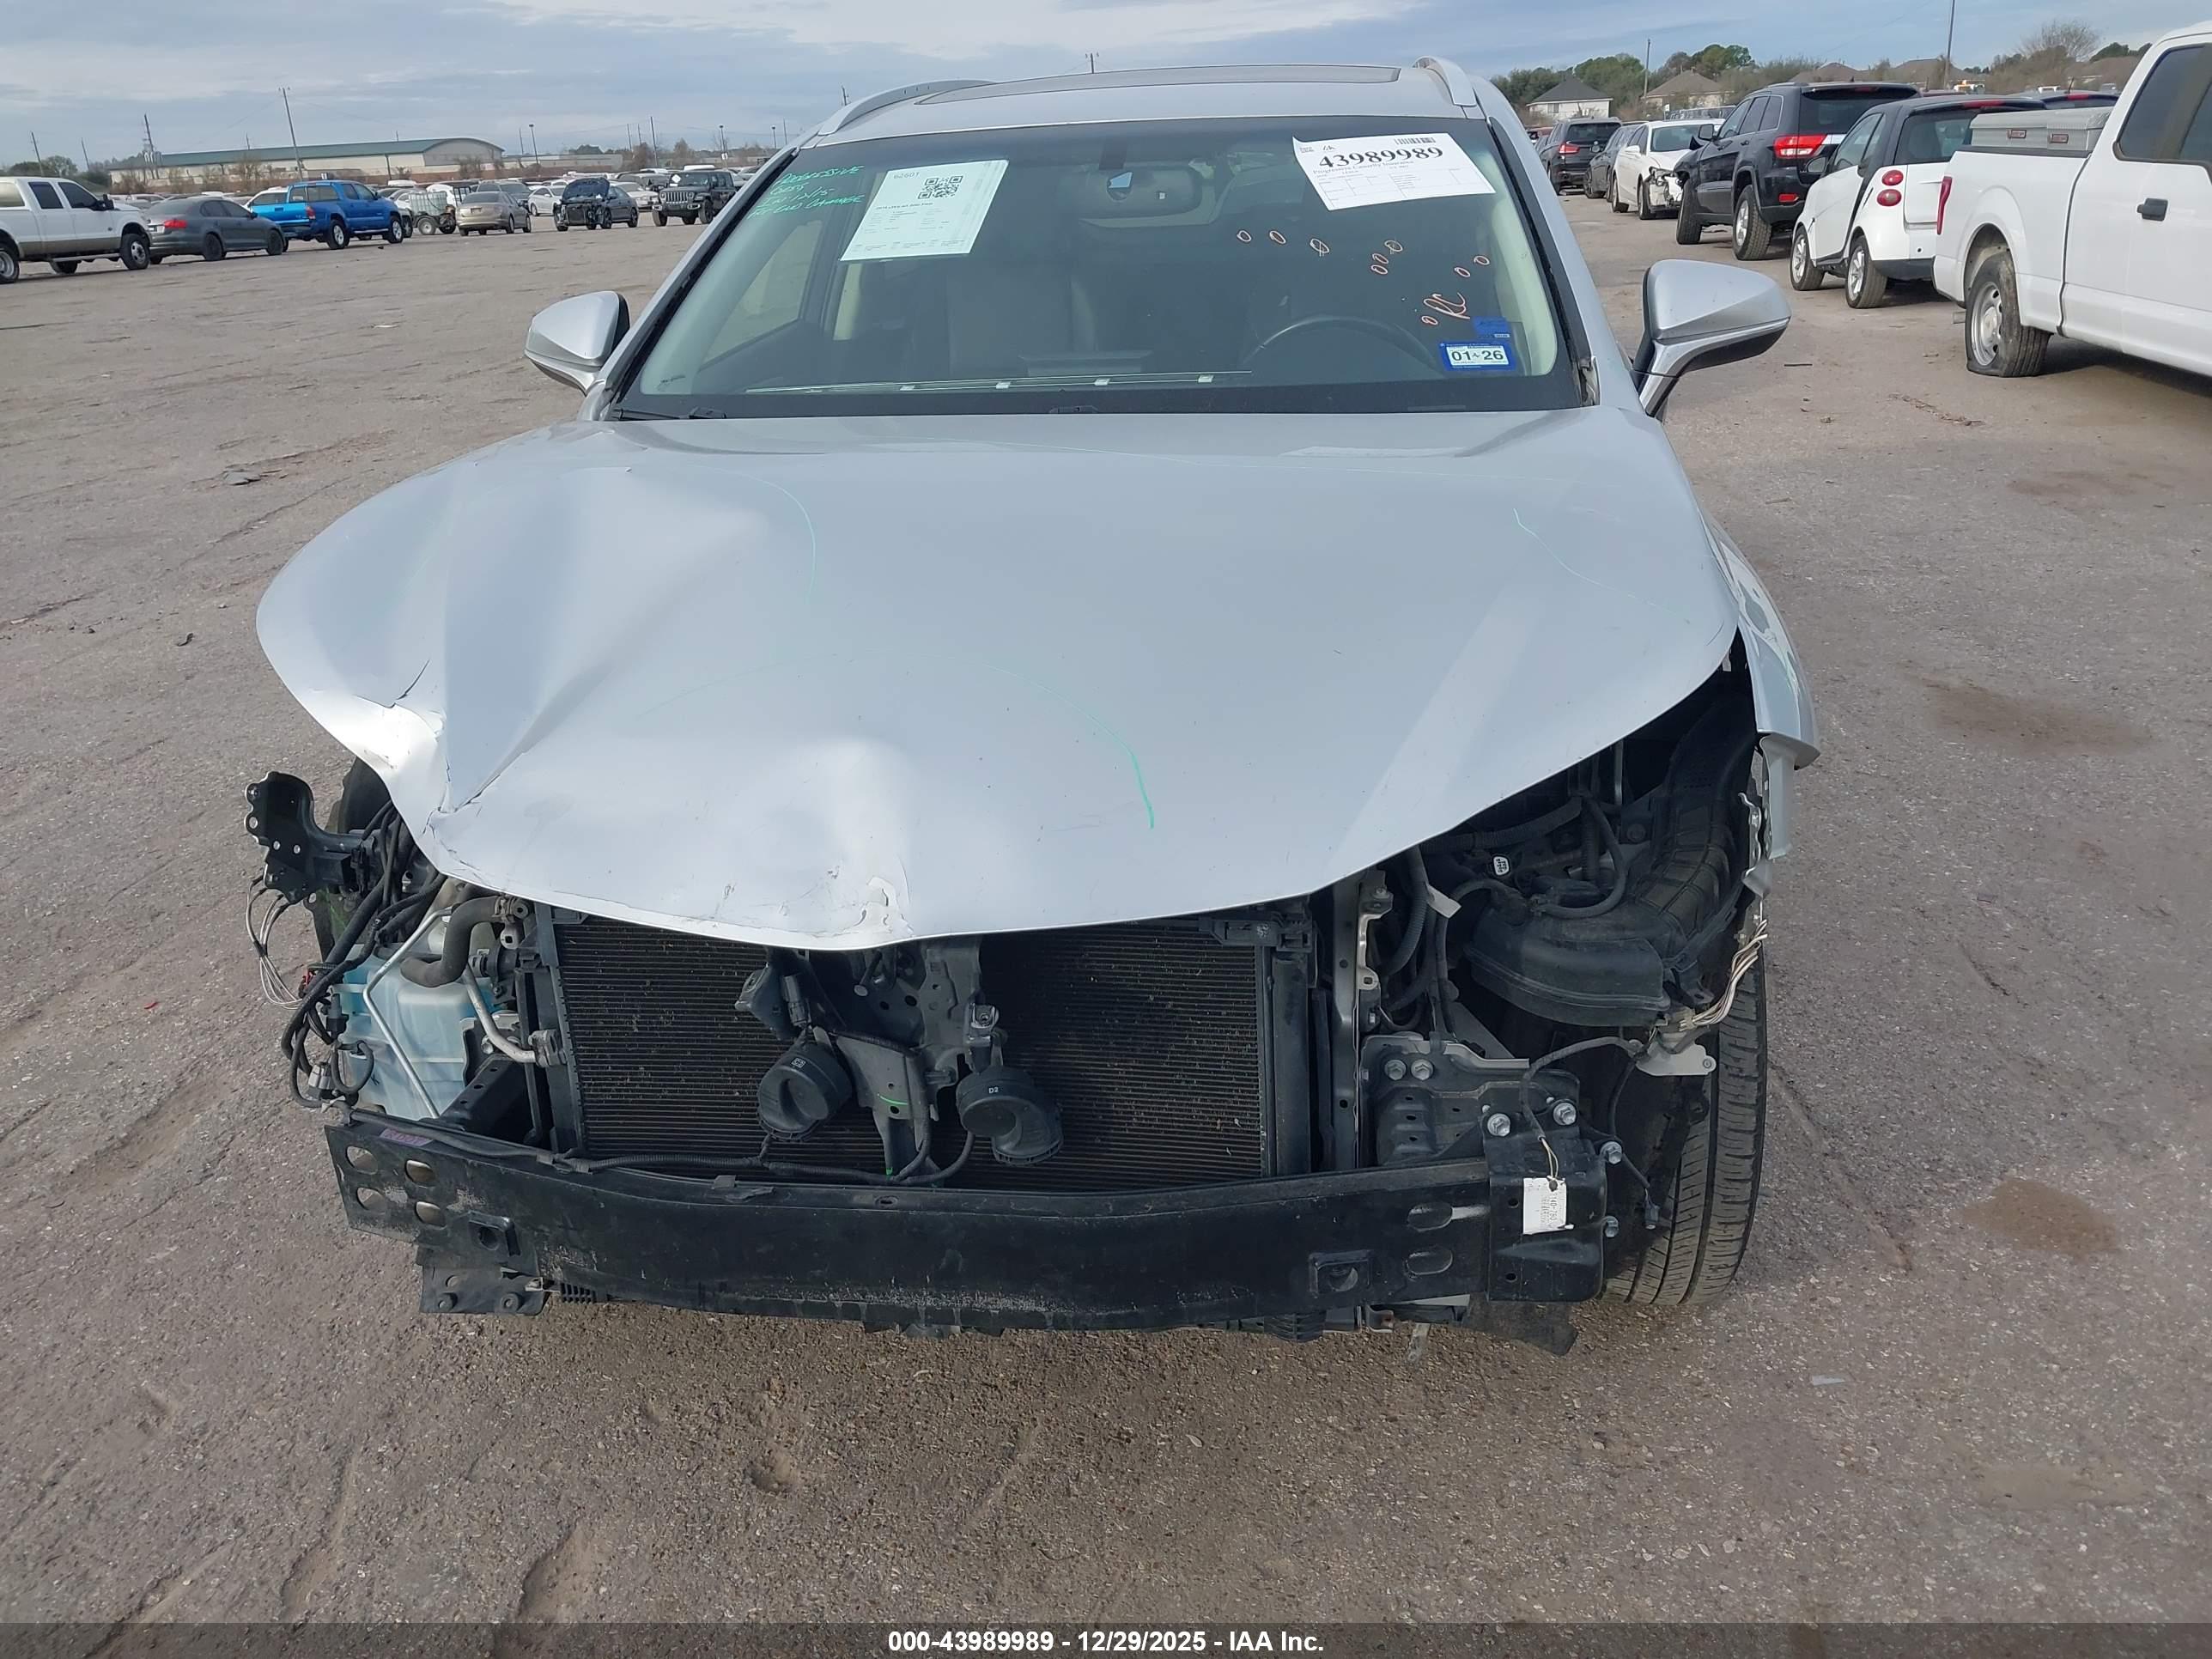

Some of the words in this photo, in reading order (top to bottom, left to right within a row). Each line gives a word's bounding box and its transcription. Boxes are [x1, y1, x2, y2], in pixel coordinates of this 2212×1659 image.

[1319, 147, 1443, 168] 43989989
[1451, 350, 1472, 362] 01
[1481, 349, 1504, 361] 26
